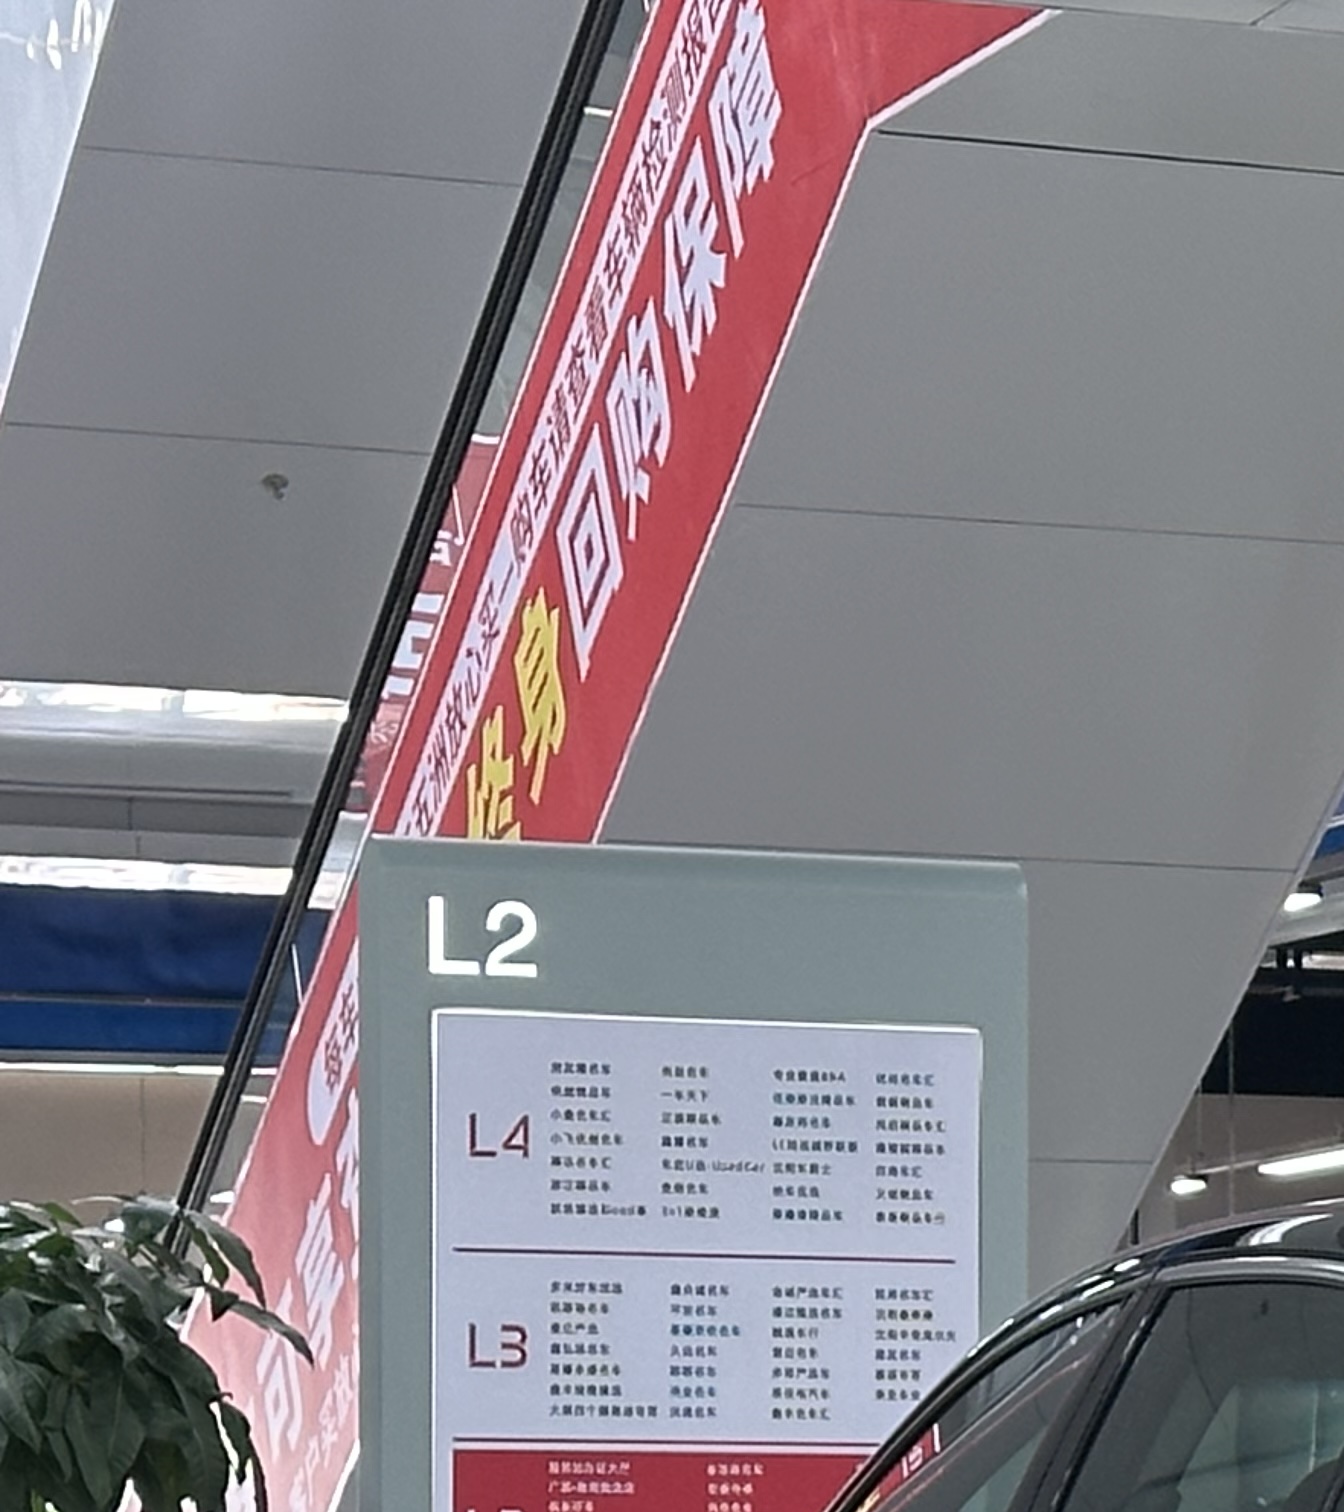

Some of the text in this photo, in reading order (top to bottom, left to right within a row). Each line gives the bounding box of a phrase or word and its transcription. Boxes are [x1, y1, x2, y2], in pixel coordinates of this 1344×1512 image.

[427, 895, 539, 978] L2
[468, 1112, 531, 1159] L4
[468, 1322, 529, 1369] L3
